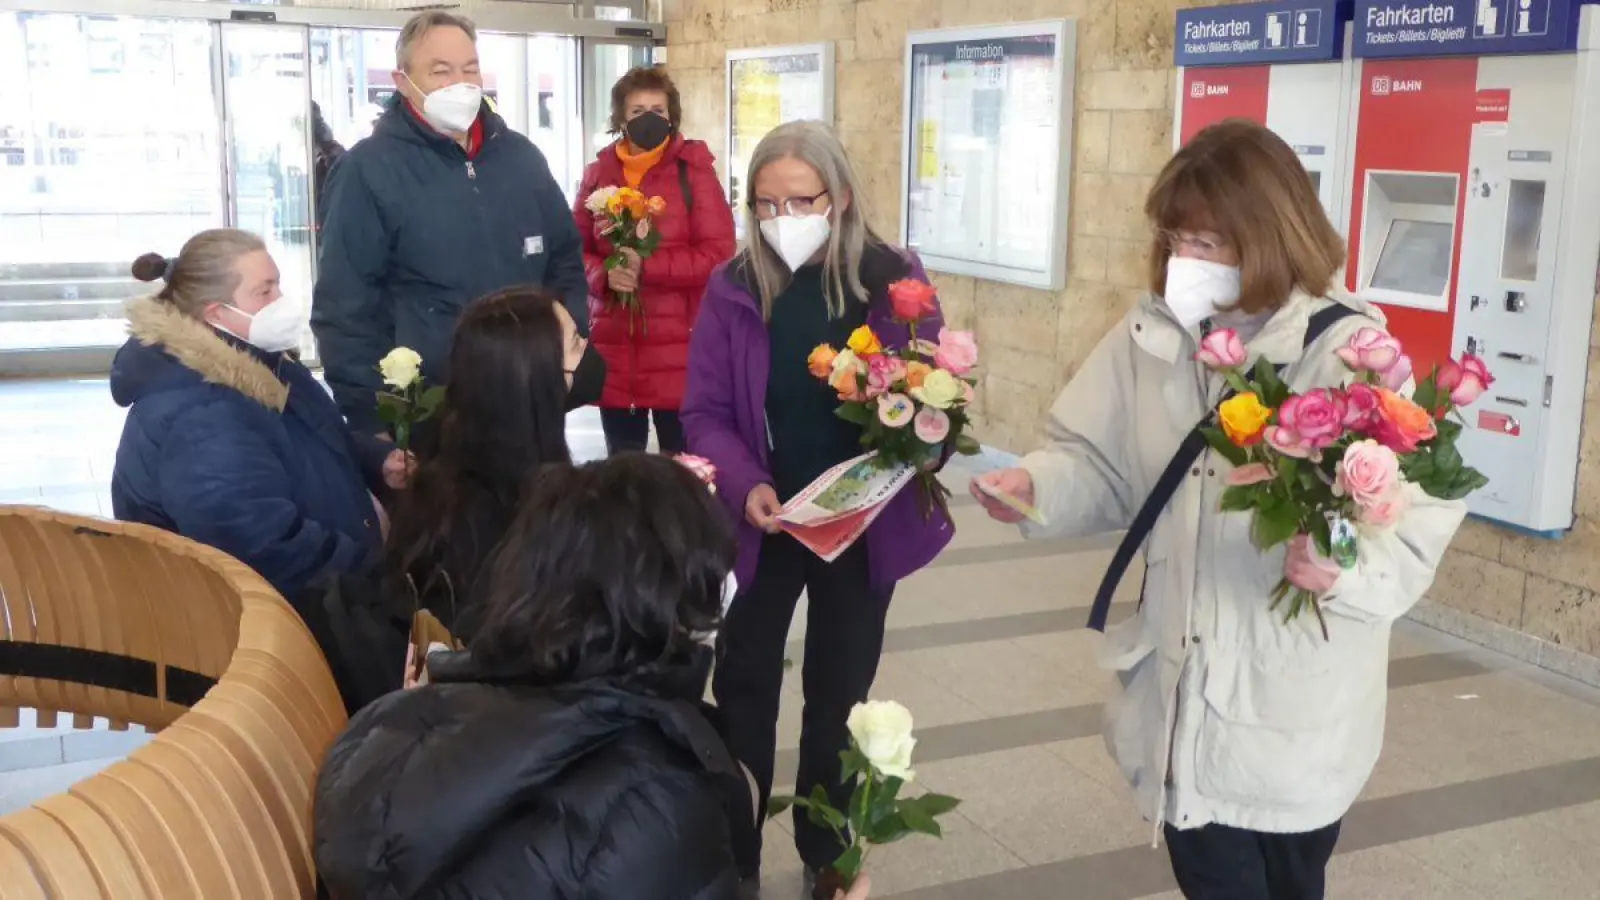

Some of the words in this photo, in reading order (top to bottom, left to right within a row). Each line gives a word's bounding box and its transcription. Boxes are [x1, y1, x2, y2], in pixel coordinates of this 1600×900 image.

[1366, 4, 1454, 28] Fahrkarten
[1184, 20, 1250, 39] Fahrkarten
[955, 43, 1004, 59] Information
[1206, 85, 1229, 95] BAHN
[1372, 76, 1390, 95] DB
[1393, 79, 1422, 92] BAHN
